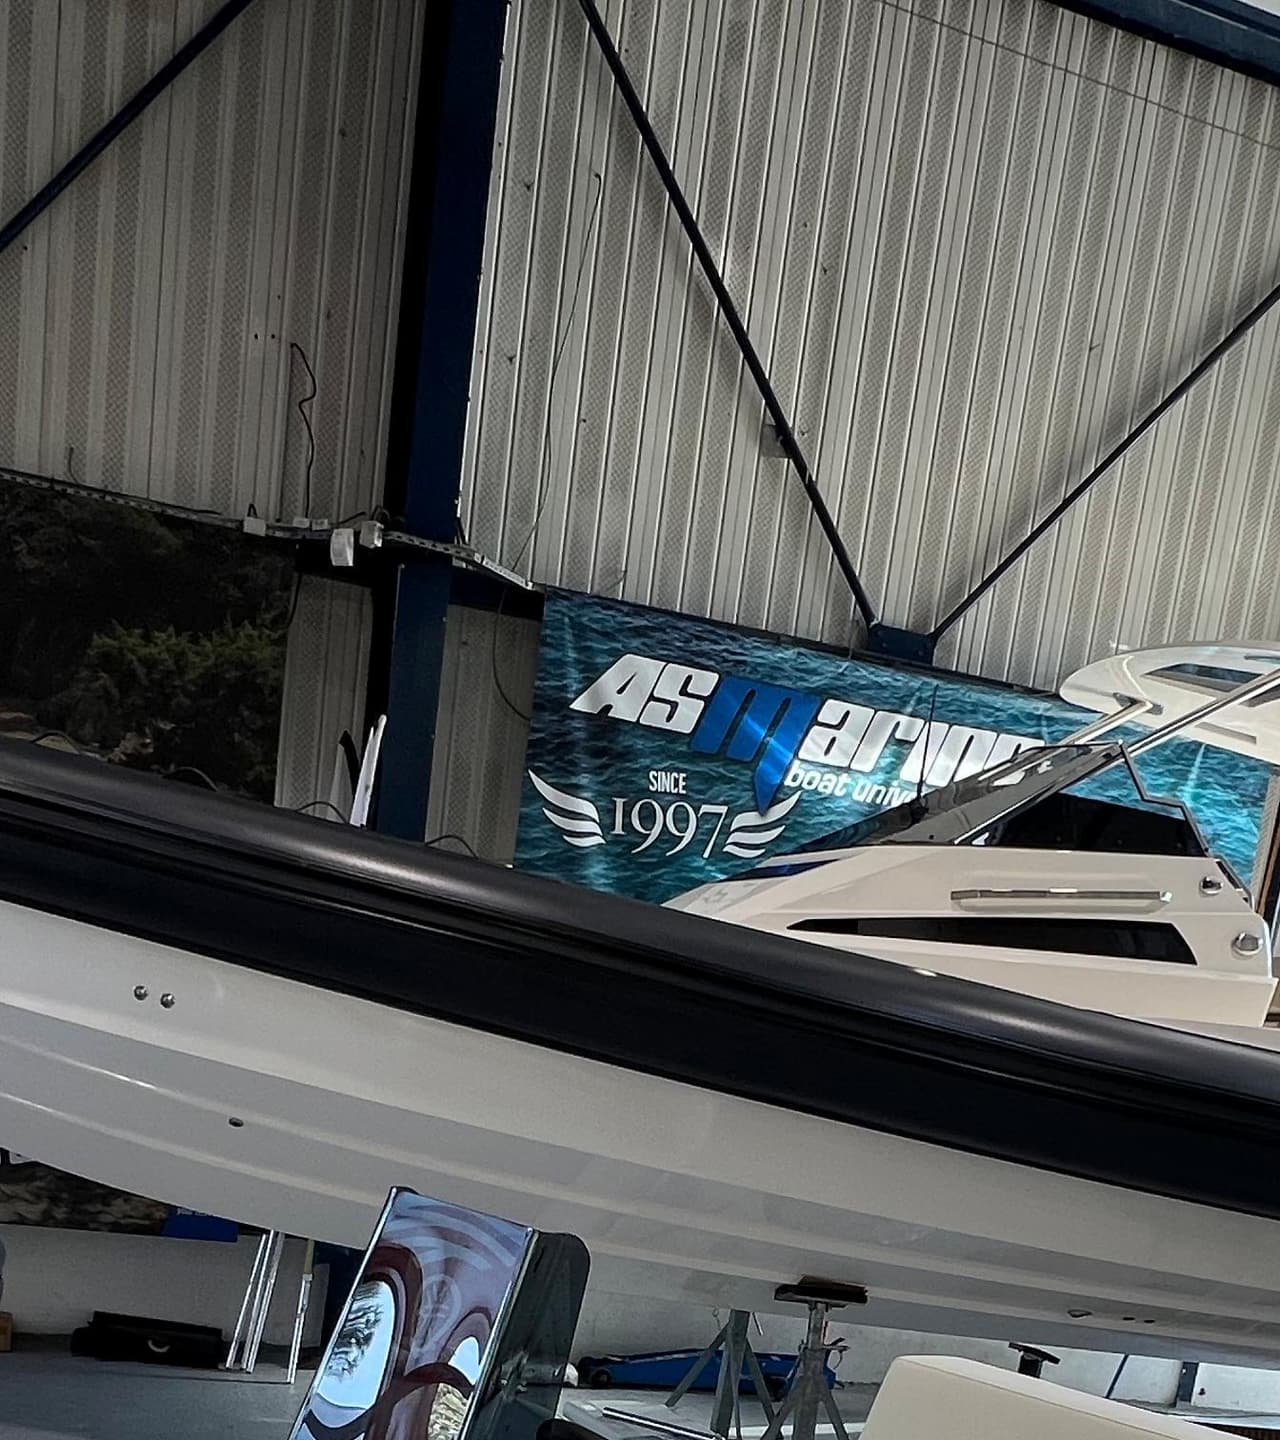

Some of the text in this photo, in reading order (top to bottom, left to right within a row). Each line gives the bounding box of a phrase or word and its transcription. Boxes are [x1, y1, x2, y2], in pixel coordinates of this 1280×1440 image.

[649, 770, 687, 796] SINCE
[784, 765, 853, 794] boat
[611, 797, 729, 860] 1997
